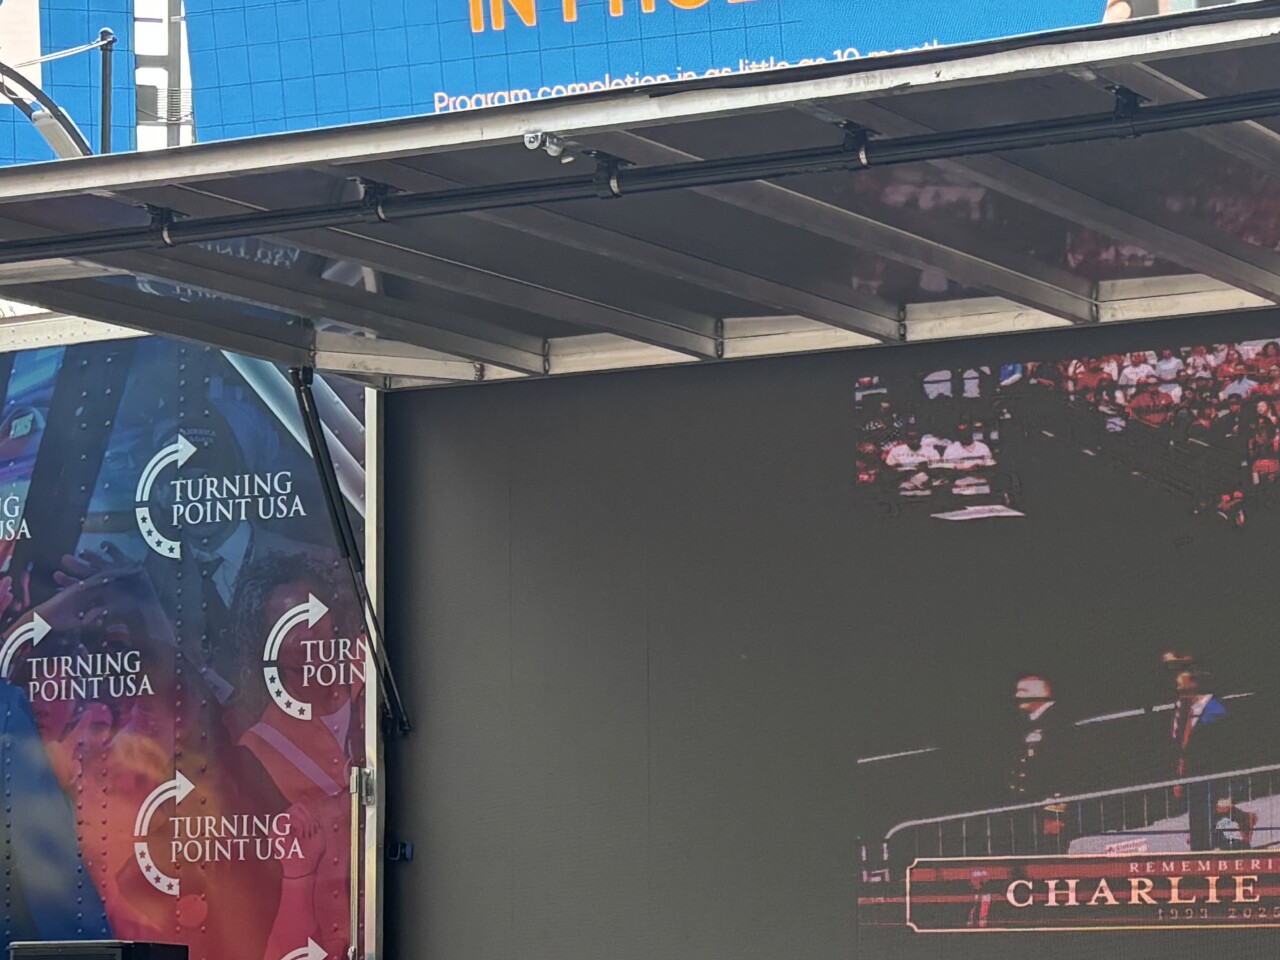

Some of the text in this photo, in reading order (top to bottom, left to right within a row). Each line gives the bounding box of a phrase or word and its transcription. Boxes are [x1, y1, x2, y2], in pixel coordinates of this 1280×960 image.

[170, 471, 292, 502] TURNING
[171, 495, 307, 525] POINT USA
[26, 651, 141, 679] TURNING
[28, 674, 155, 702] POINT USA
[169, 813, 291, 839] TURNING
[170, 837, 305, 862] POINT USA
[1006, 874, 1261, 908] CHARLIE
